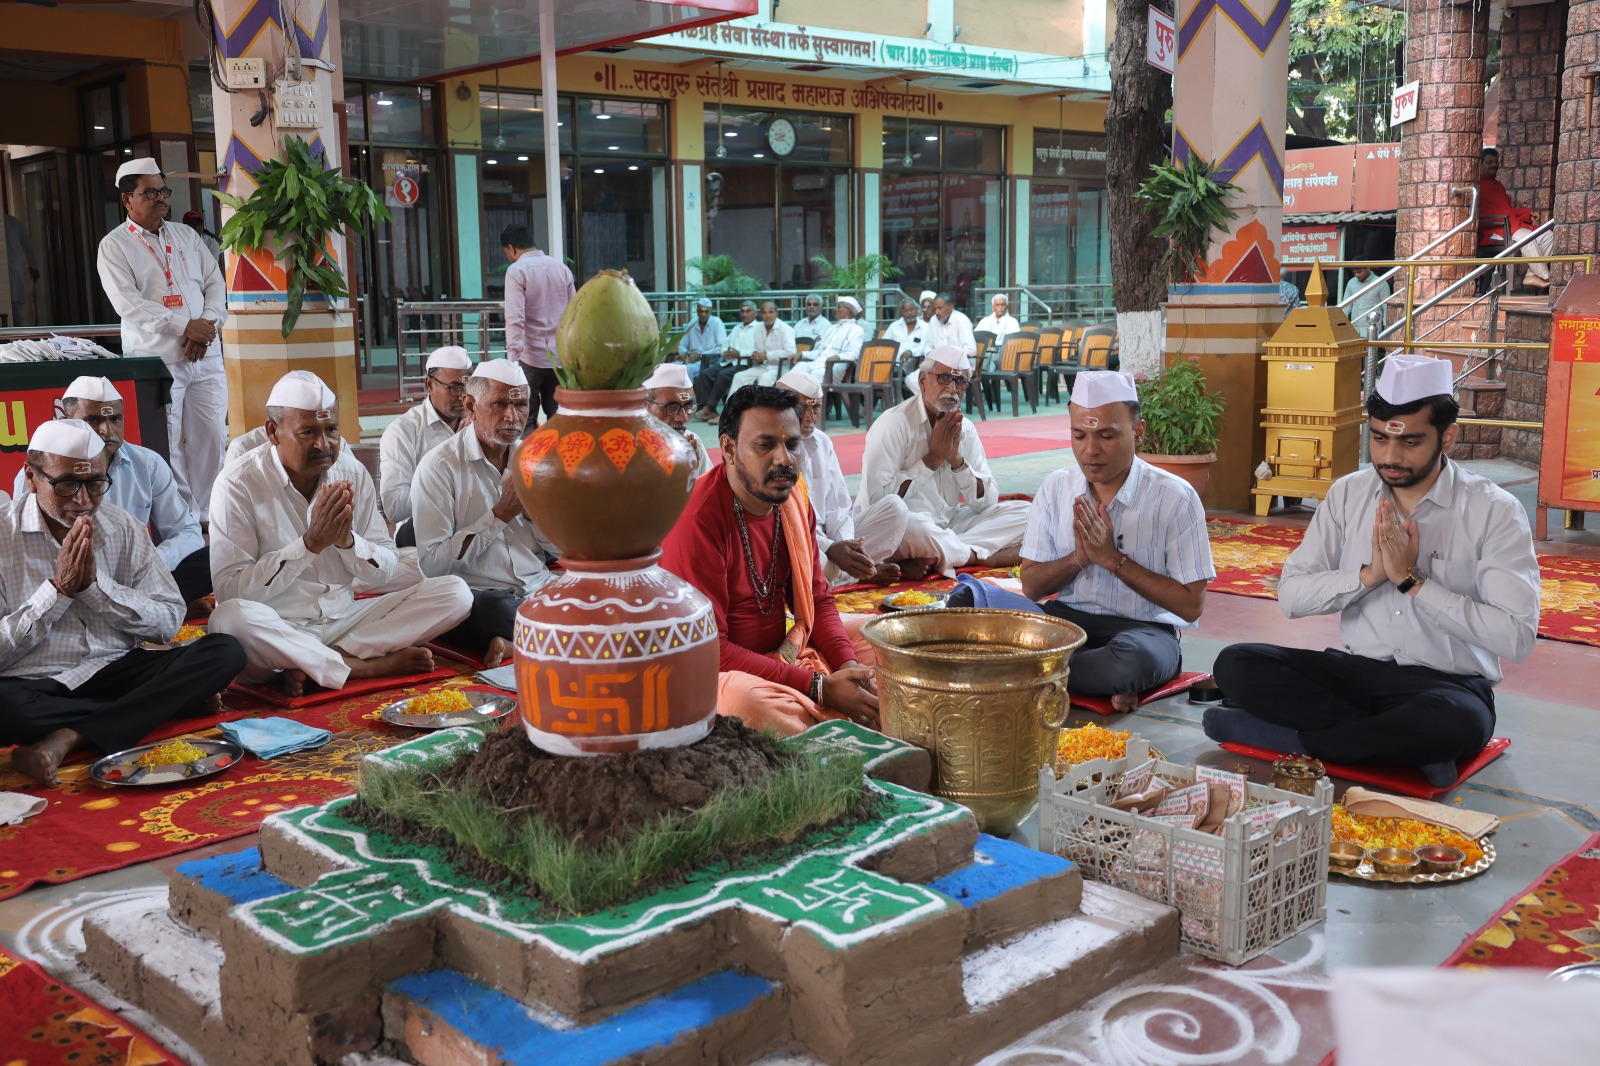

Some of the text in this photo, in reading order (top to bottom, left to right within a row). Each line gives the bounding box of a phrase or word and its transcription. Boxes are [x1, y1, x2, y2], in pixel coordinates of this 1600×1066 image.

[719, 22, 748, 46] सेवा
[750, 26, 786, 50] संस्था
[745, 80, 786, 104] प्रसाद
[792, 84, 846, 106] महाराज
[1393, 89, 1415, 119] पुरुष
[1574, 330, 1586, 345] 2
[1574, 347, 1584, 361] 1
